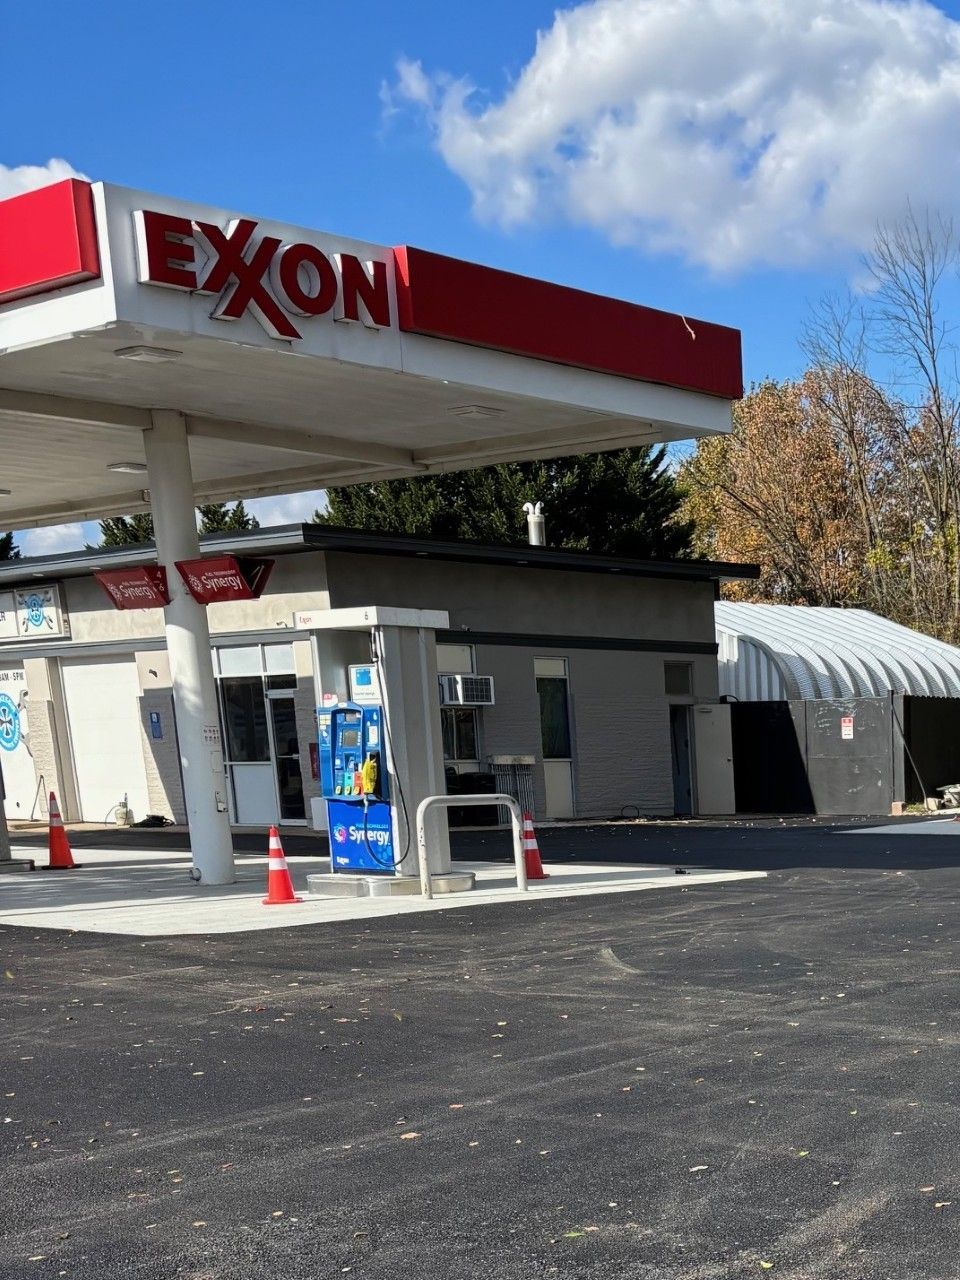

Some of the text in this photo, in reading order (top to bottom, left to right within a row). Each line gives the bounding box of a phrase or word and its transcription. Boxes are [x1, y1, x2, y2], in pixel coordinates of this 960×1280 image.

[135, 209, 391, 341] EXXON
[119, 584, 157, 600] Synergy
[201, 575, 243, 592] Synergy
